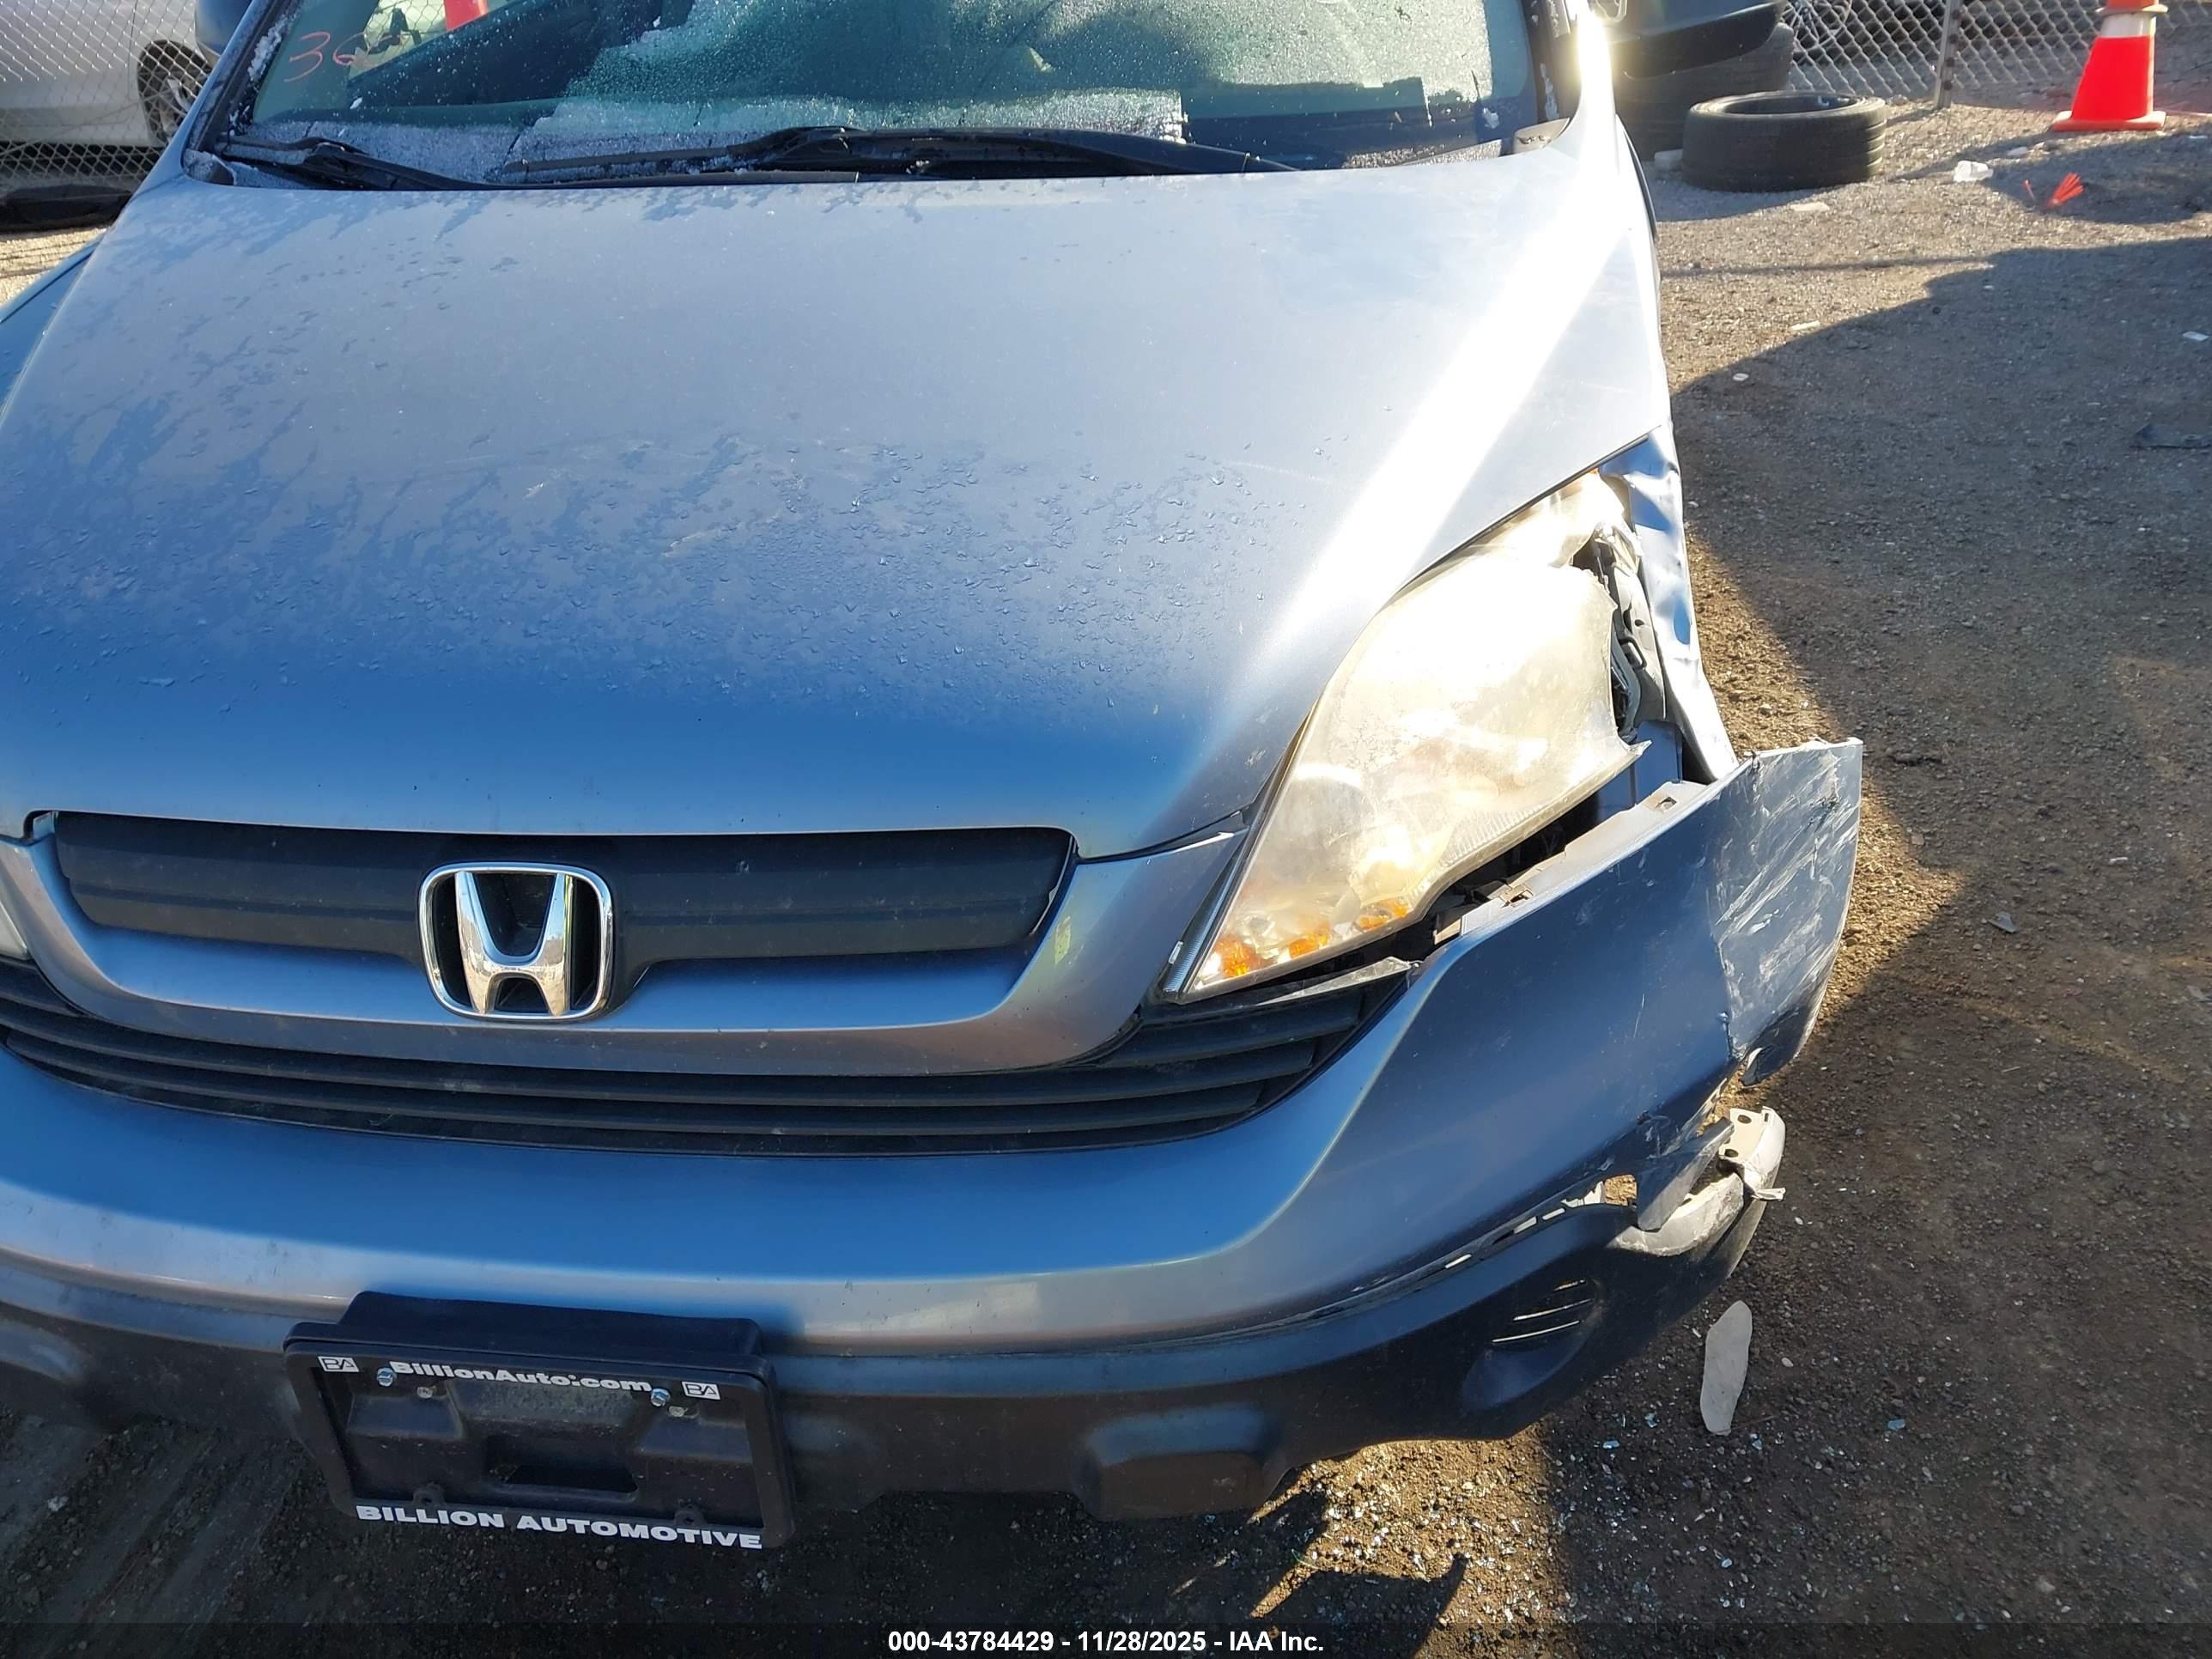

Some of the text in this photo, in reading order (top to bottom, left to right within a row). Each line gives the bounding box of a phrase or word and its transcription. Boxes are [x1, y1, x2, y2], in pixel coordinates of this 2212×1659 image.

[388, 1360, 652, 1392] BillionAuto.com
[356, 1505, 763, 1550] BILLION AUTOMOTIVE
